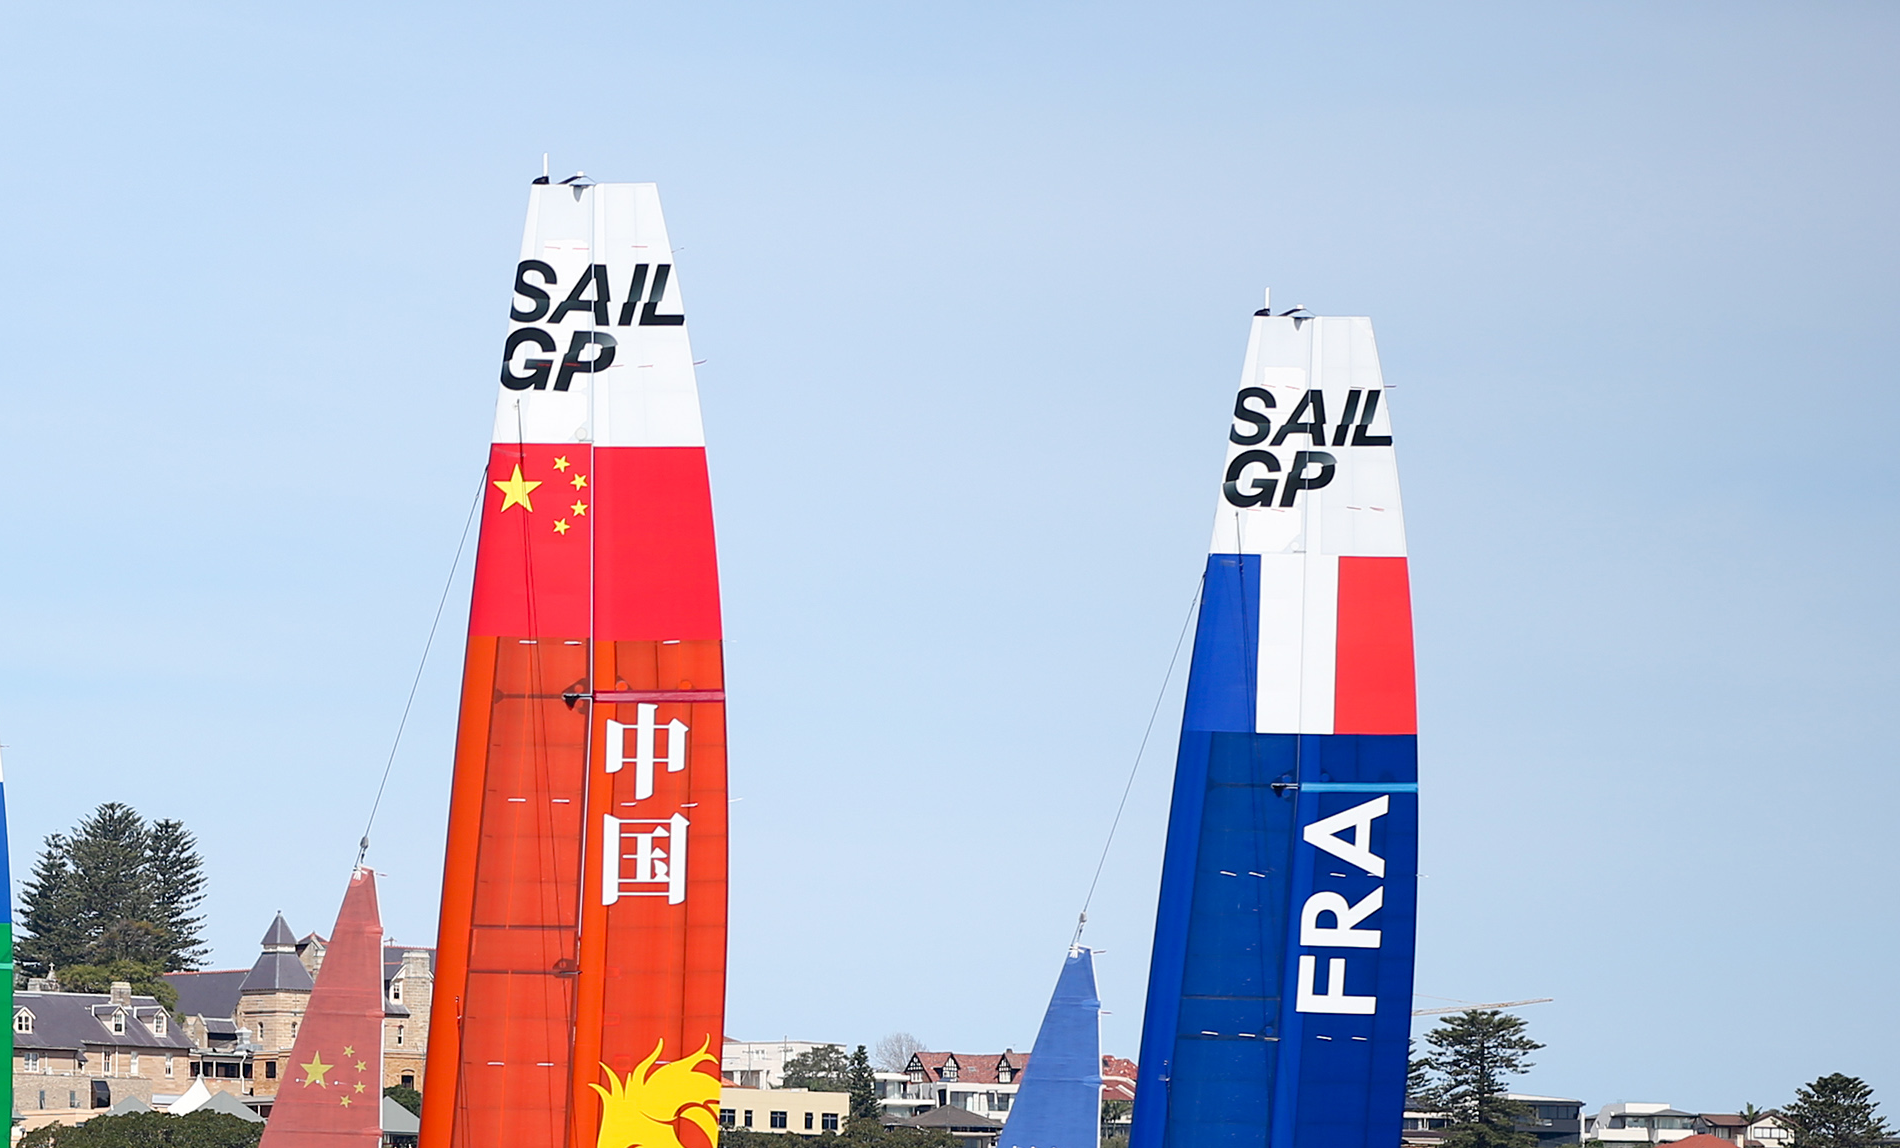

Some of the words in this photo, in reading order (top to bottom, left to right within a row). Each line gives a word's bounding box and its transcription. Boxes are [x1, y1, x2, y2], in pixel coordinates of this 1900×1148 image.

[509, 259, 685, 327] SAIL
[500, 328, 616, 392] GP
[1229, 386, 1393, 447] SAIL
[1223, 449, 1336, 508] GP
[601, 702, 690, 906] 中国
[1295, 794, 1389, 1015] FRA
